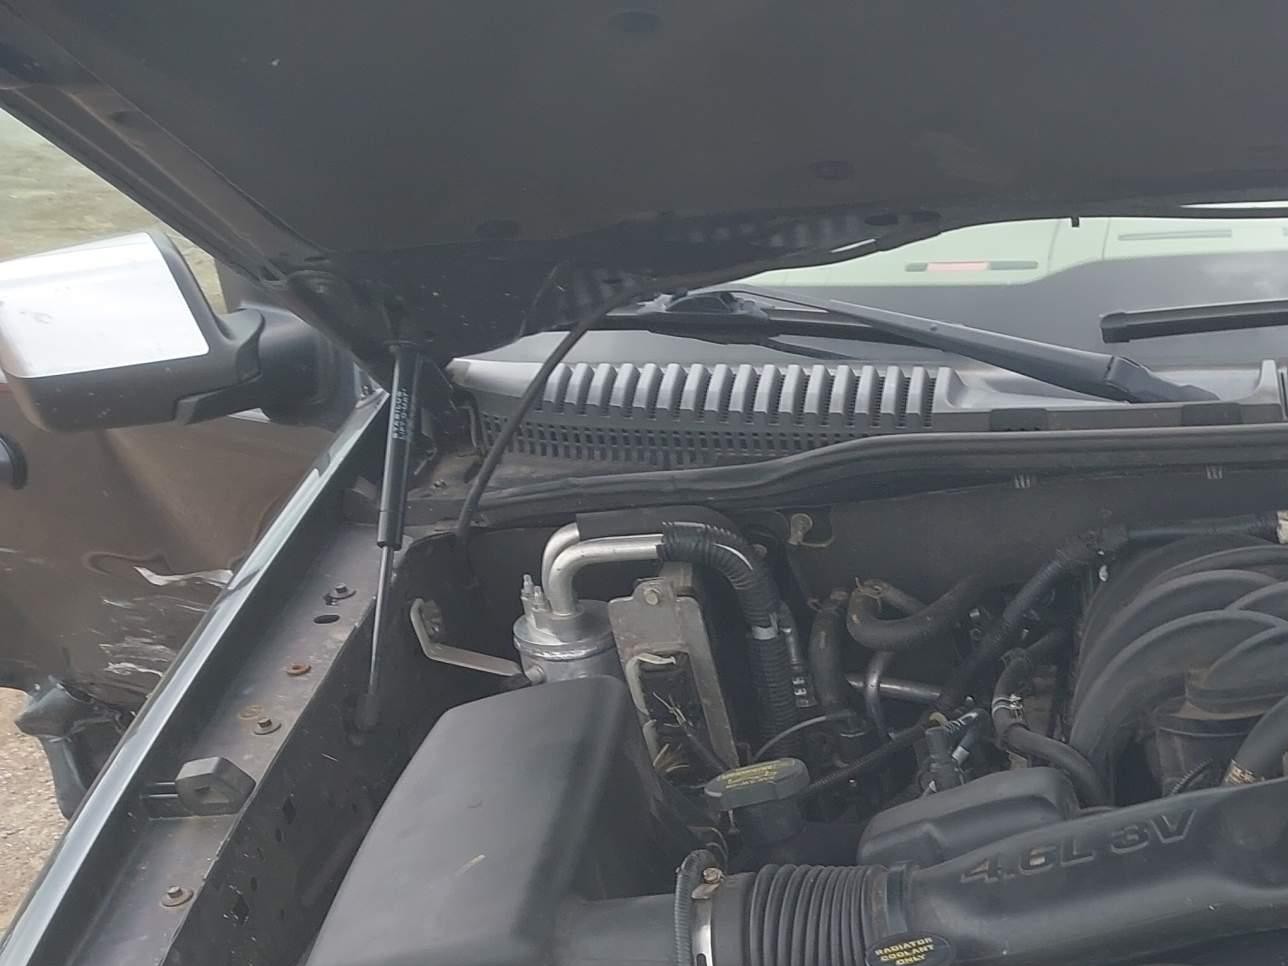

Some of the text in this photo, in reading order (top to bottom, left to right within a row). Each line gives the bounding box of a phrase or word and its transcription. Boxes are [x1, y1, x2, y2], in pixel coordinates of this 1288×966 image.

[960, 807, 1198, 884] 4.6L 3V
[874, 937, 934, 956] RADIATOR
[880, 944, 935, 962] COOLANT
[895, 953, 926, 966] ONLY
